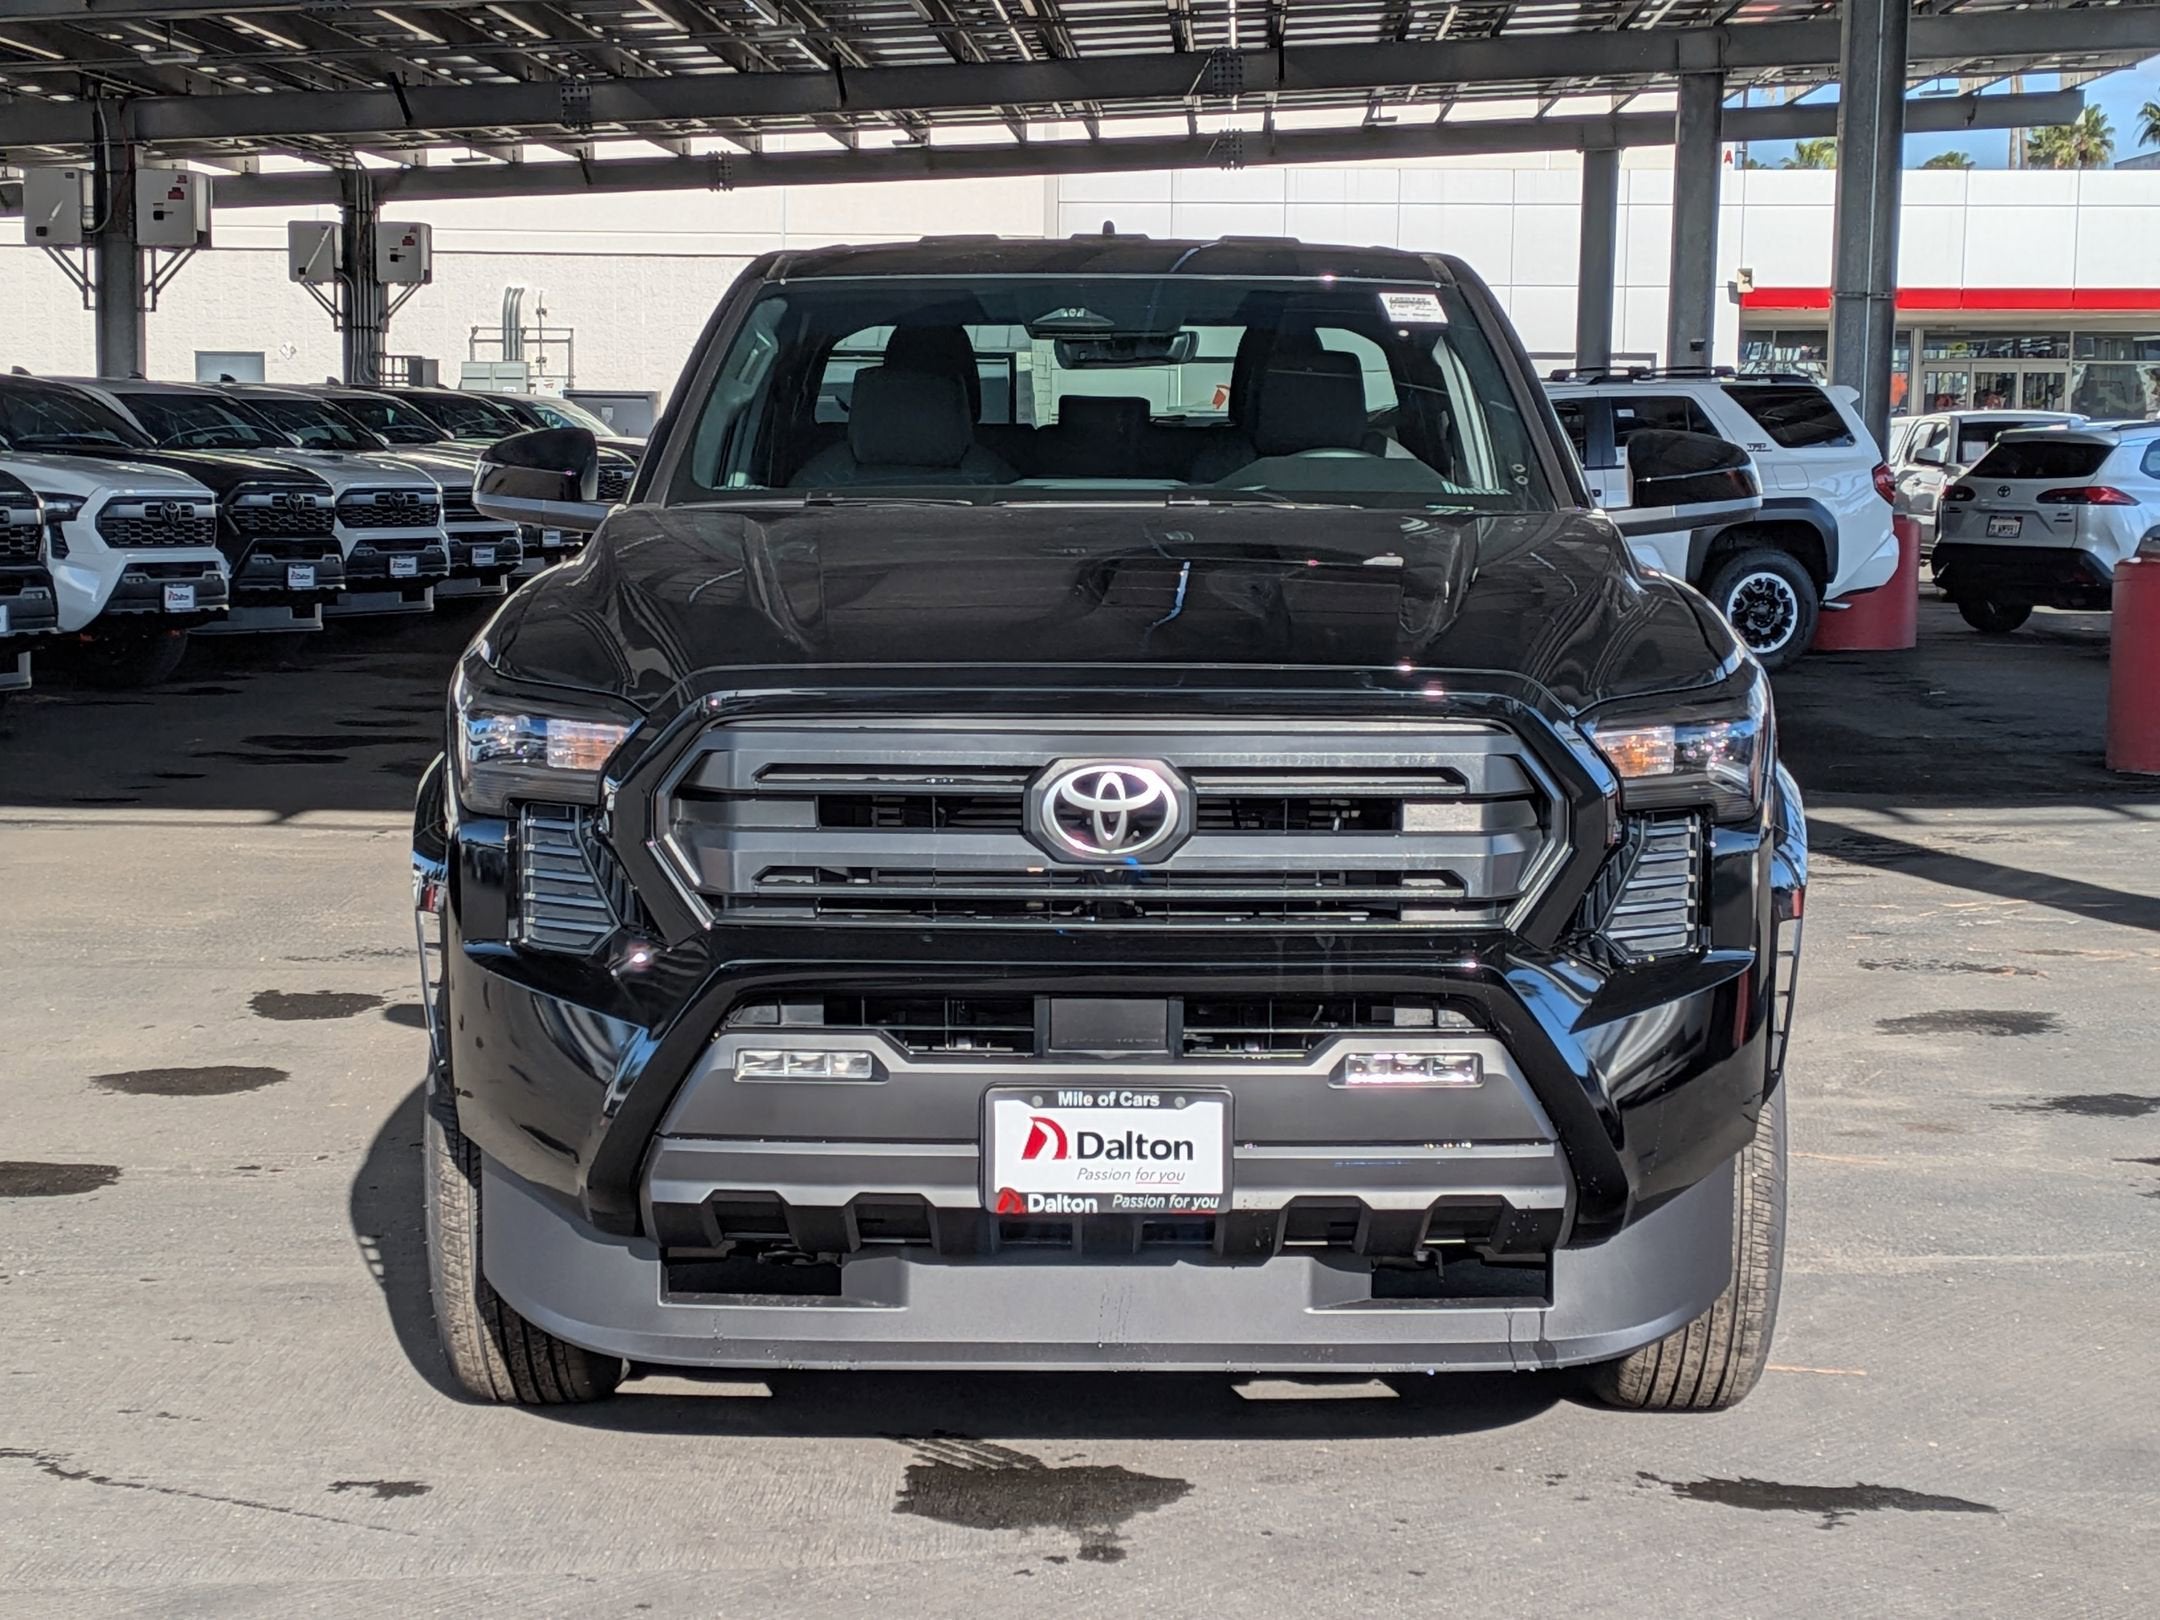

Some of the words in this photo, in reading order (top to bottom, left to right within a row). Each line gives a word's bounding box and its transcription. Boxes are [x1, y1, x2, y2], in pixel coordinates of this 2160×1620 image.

[1058, 1091, 1093, 1107] Mile
[1097, 1091, 1117, 1107] of
[1119, 1092, 1160, 1107] Cars
[1077, 1130, 1194, 1161] Dalton
[1076, 1167, 1131, 1181] Passion
[1135, 1167, 1155, 1182] for
[1156, 1170, 1185, 1182] you
[1028, 1193, 1098, 1213] Dalton
[1112, 1194, 1165, 1208] Passion
[1168, 1194, 1190, 1209] for
[1193, 1197, 1219, 1210] you
